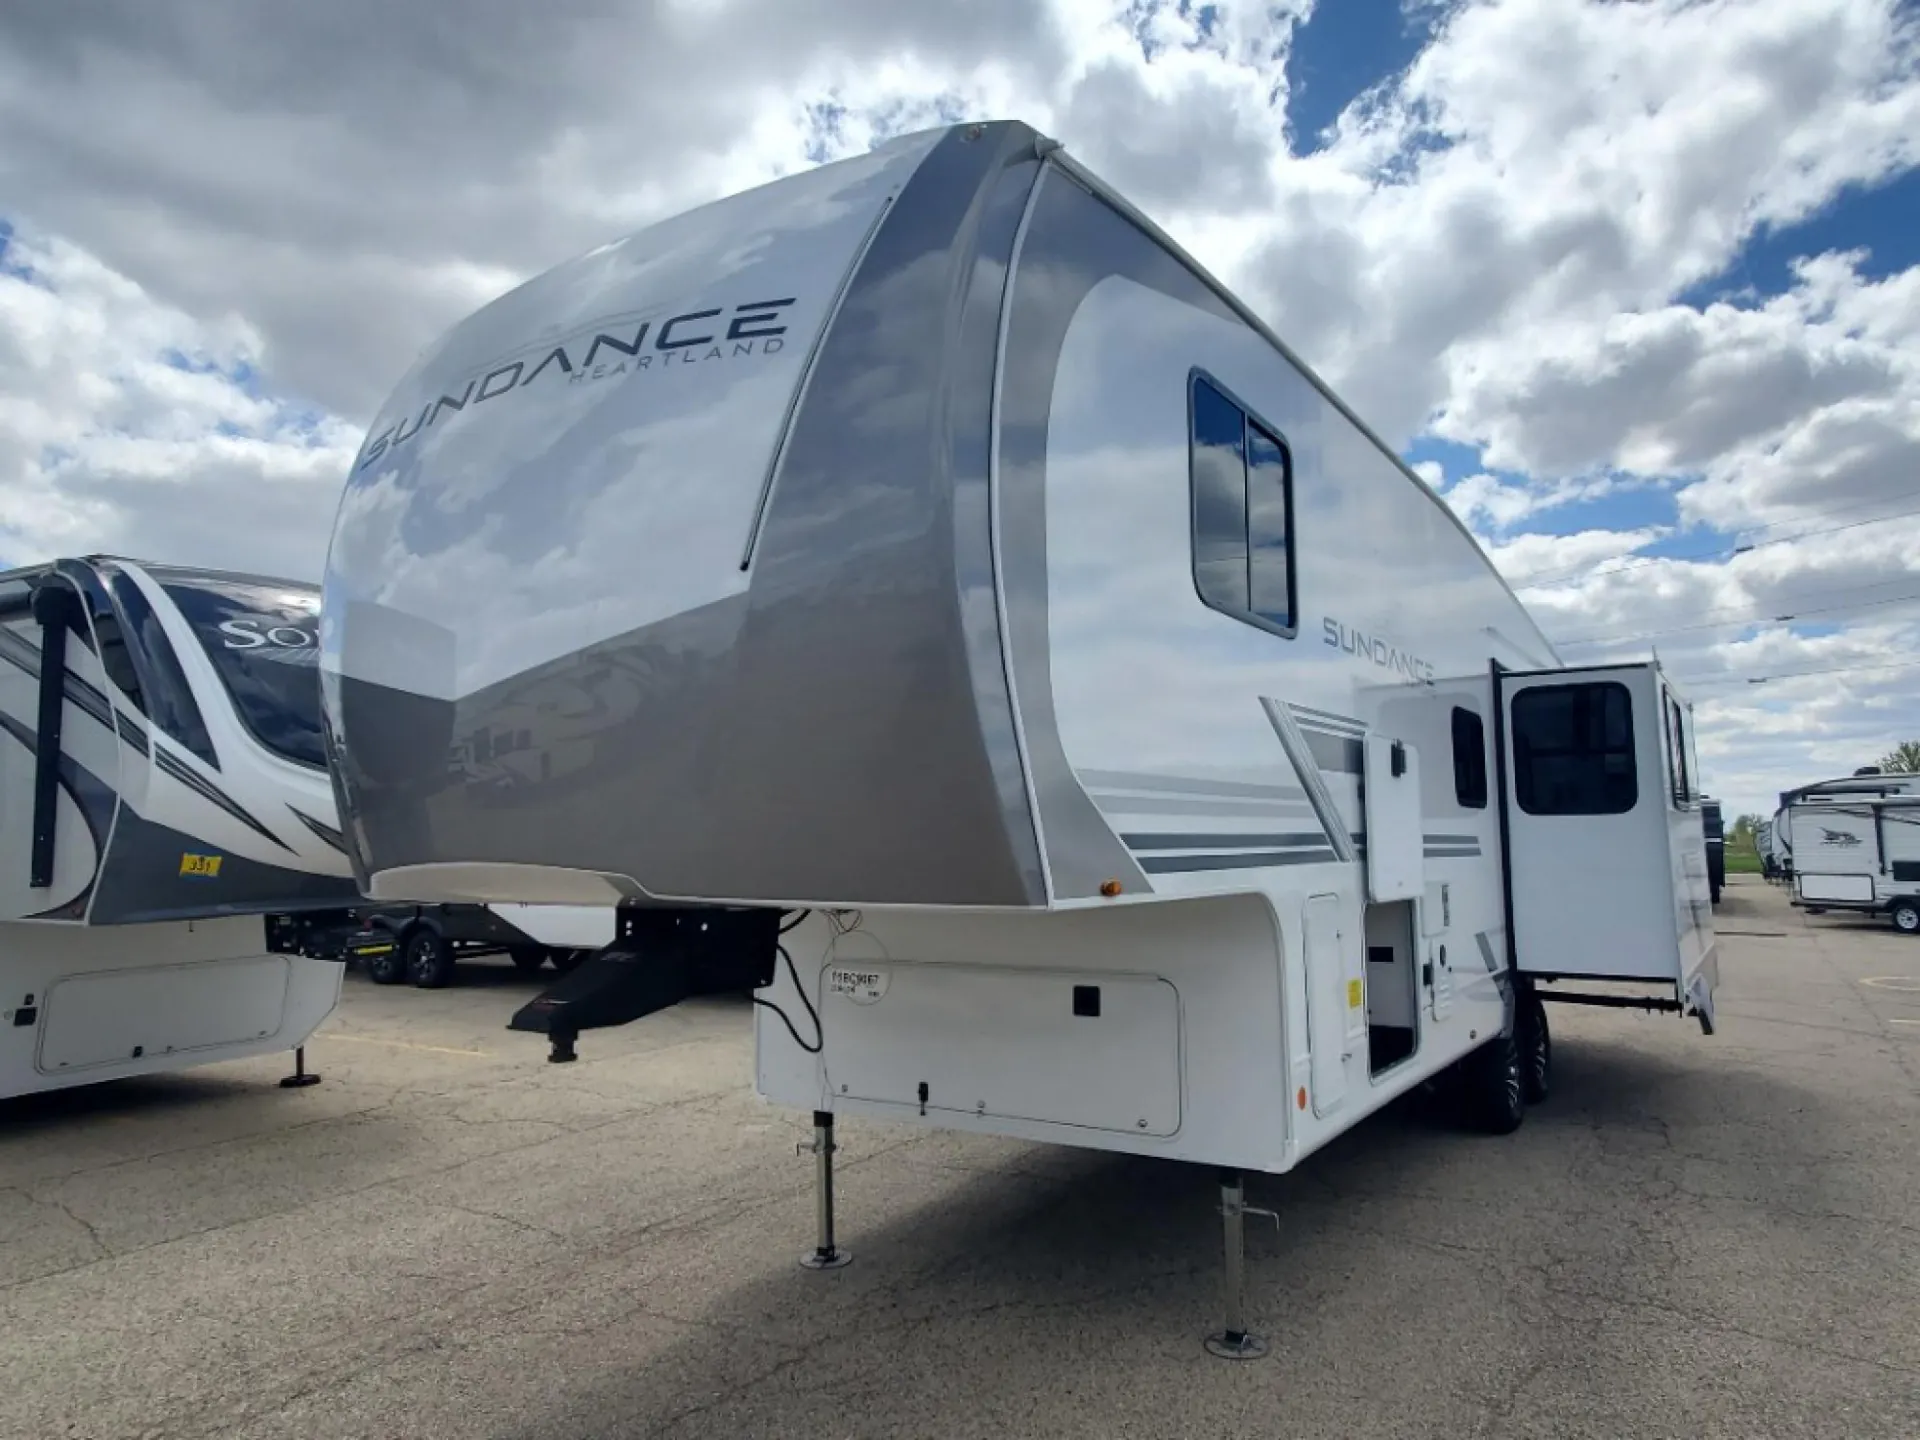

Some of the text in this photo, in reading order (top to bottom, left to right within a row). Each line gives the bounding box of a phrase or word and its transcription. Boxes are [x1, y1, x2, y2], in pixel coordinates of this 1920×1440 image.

[361, 297, 797, 470] SUNDANCE
[568, 337, 785, 386] HEARTLAND
[218, 620, 320, 648] SO
[1322, 615, 1435, 687] SUNDANCE
